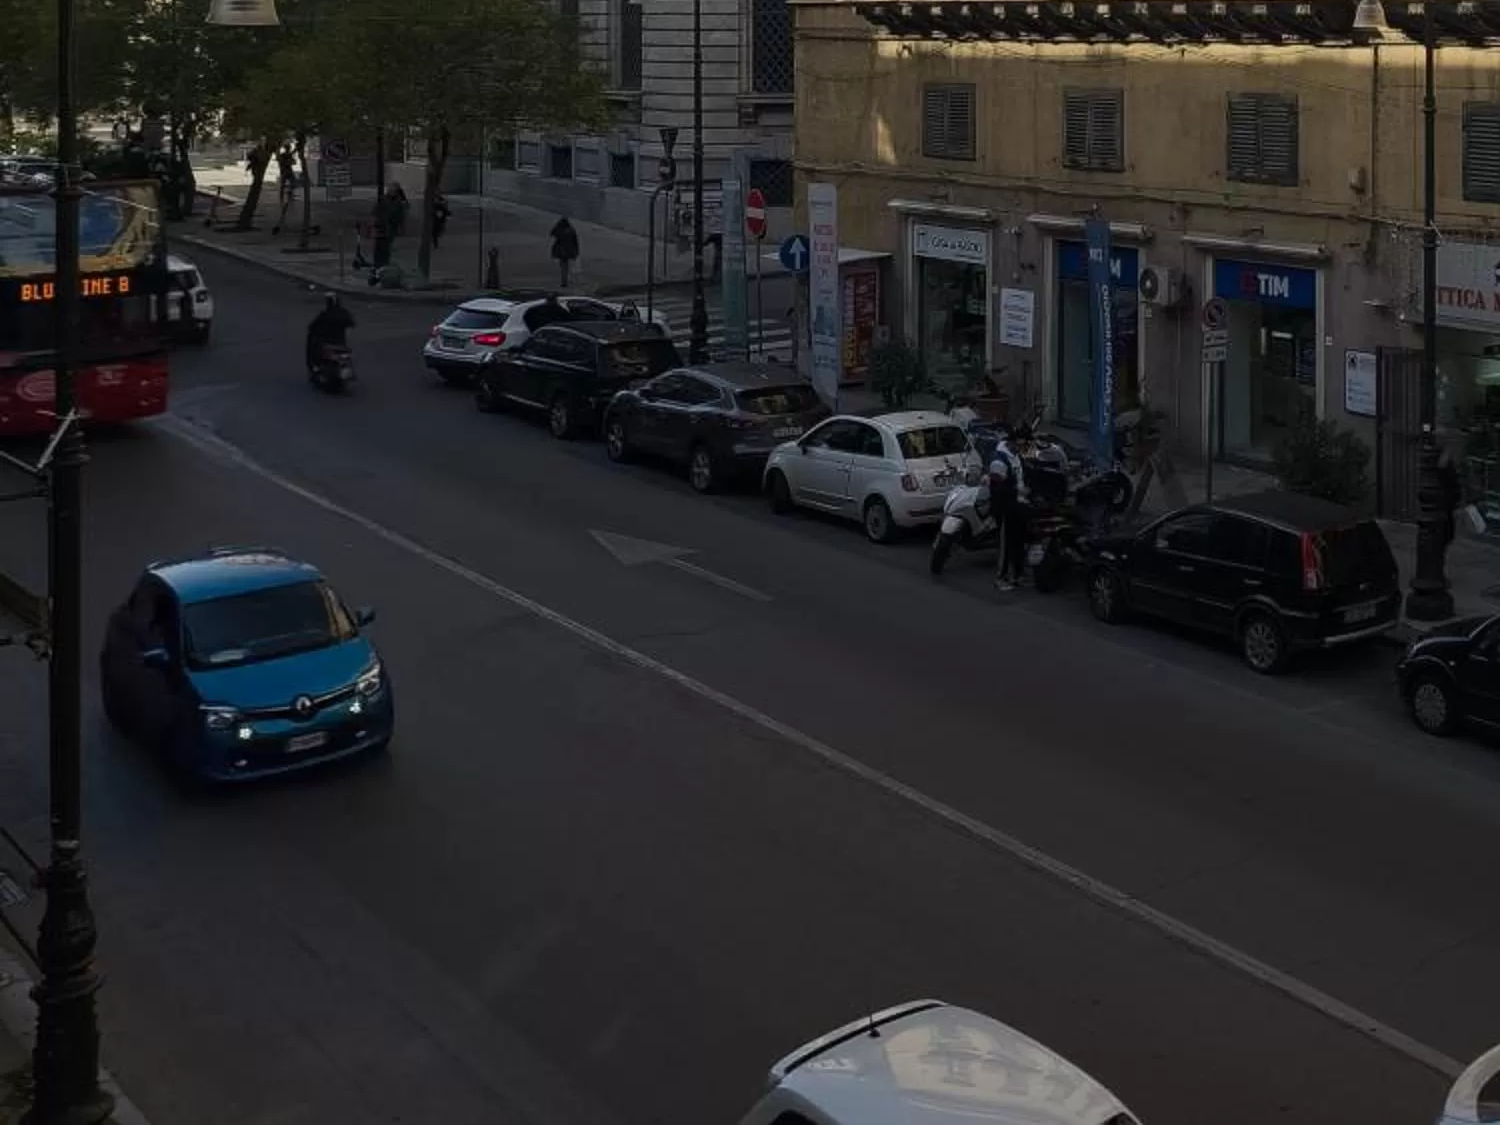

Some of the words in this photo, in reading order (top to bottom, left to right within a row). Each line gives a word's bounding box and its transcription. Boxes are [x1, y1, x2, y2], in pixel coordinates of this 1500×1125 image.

[20, 282, 56, 301] BLU
[79, 277, 112, 297] INE
[1256, 272, 1290, 299] TIM
[1436, 286, 1486, 311] TTICA
